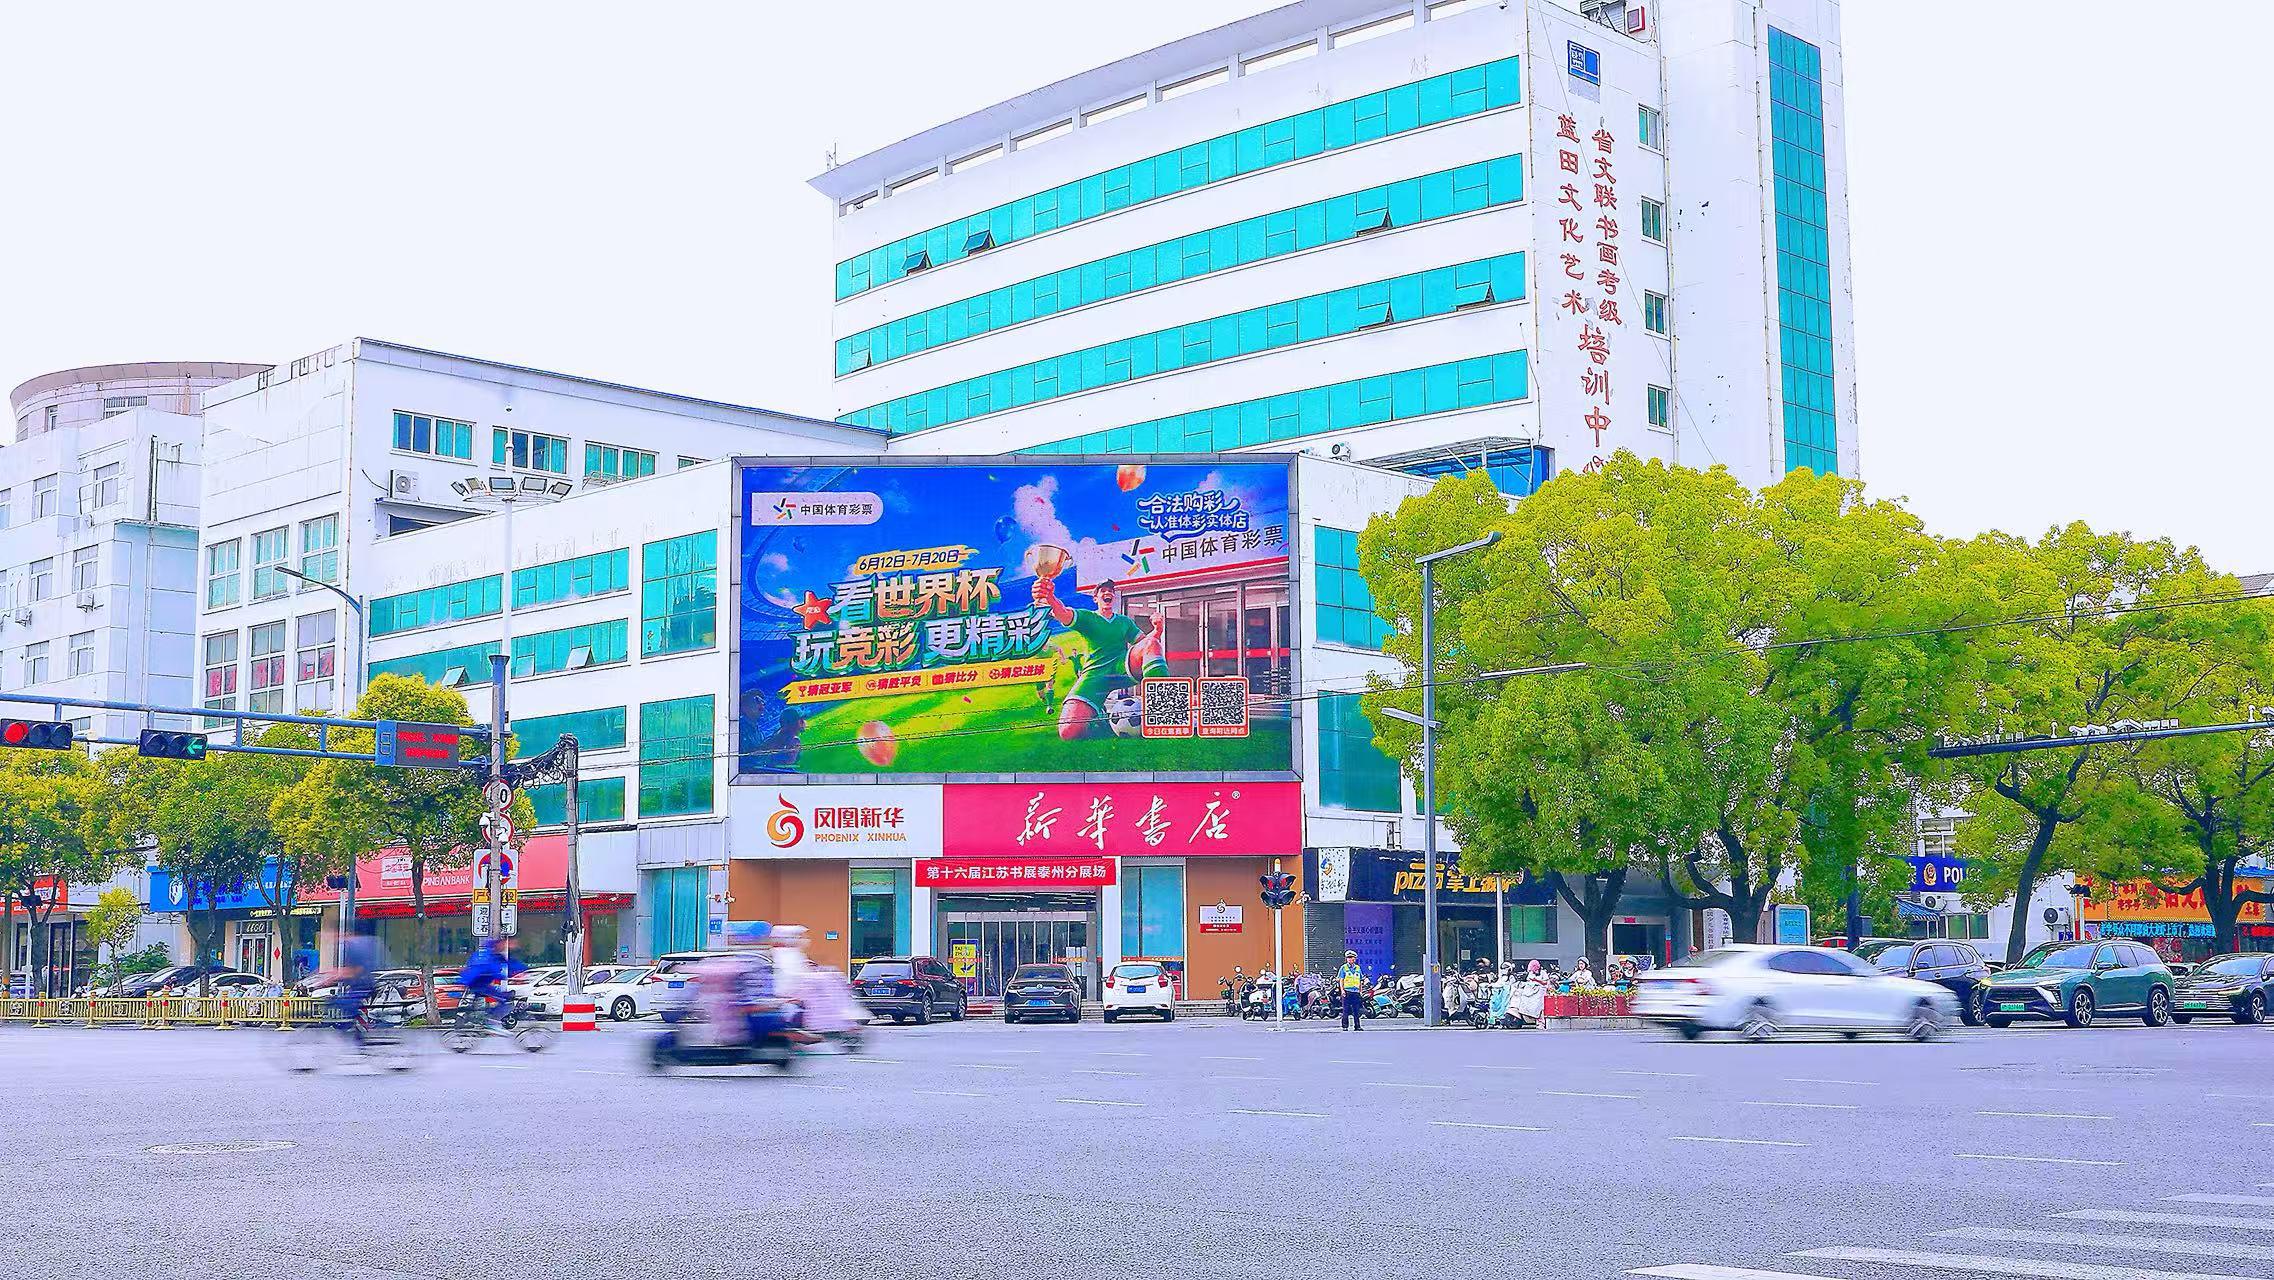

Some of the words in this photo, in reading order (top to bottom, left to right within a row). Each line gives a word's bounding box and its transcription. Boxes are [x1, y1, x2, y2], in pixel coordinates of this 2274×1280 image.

[1556, 113, 1587, 315] 蓝田文化艺术
[1591, 128, 1623, 325] 省文联书画考级
[800, 503, 873, 516] 中国体育彩票
[1139, 491, 1238, 514] 合法购彩
[1140, 511, 1247, 530] 认准体彩实体店
[1162, 524, 1283, 564] 中国体育彩票
[859, 549, 960, 571] 6月12日-7月20日
[827, 567, 1001, 622] 看世界杯
[793, 622, 916, 669] 玩竞彩
[923, 607, 1051, 662] 更精彩
[944, 670, 979, 684] 猜比分
[814, 806, 905, 829] 凤凰新华
[814, 833, 860, 842] PHOENIX
[867, 832, 907, 842] XINHUA
[926, 865, 1107, 880] 第十六届江苏书展泰州分展场
